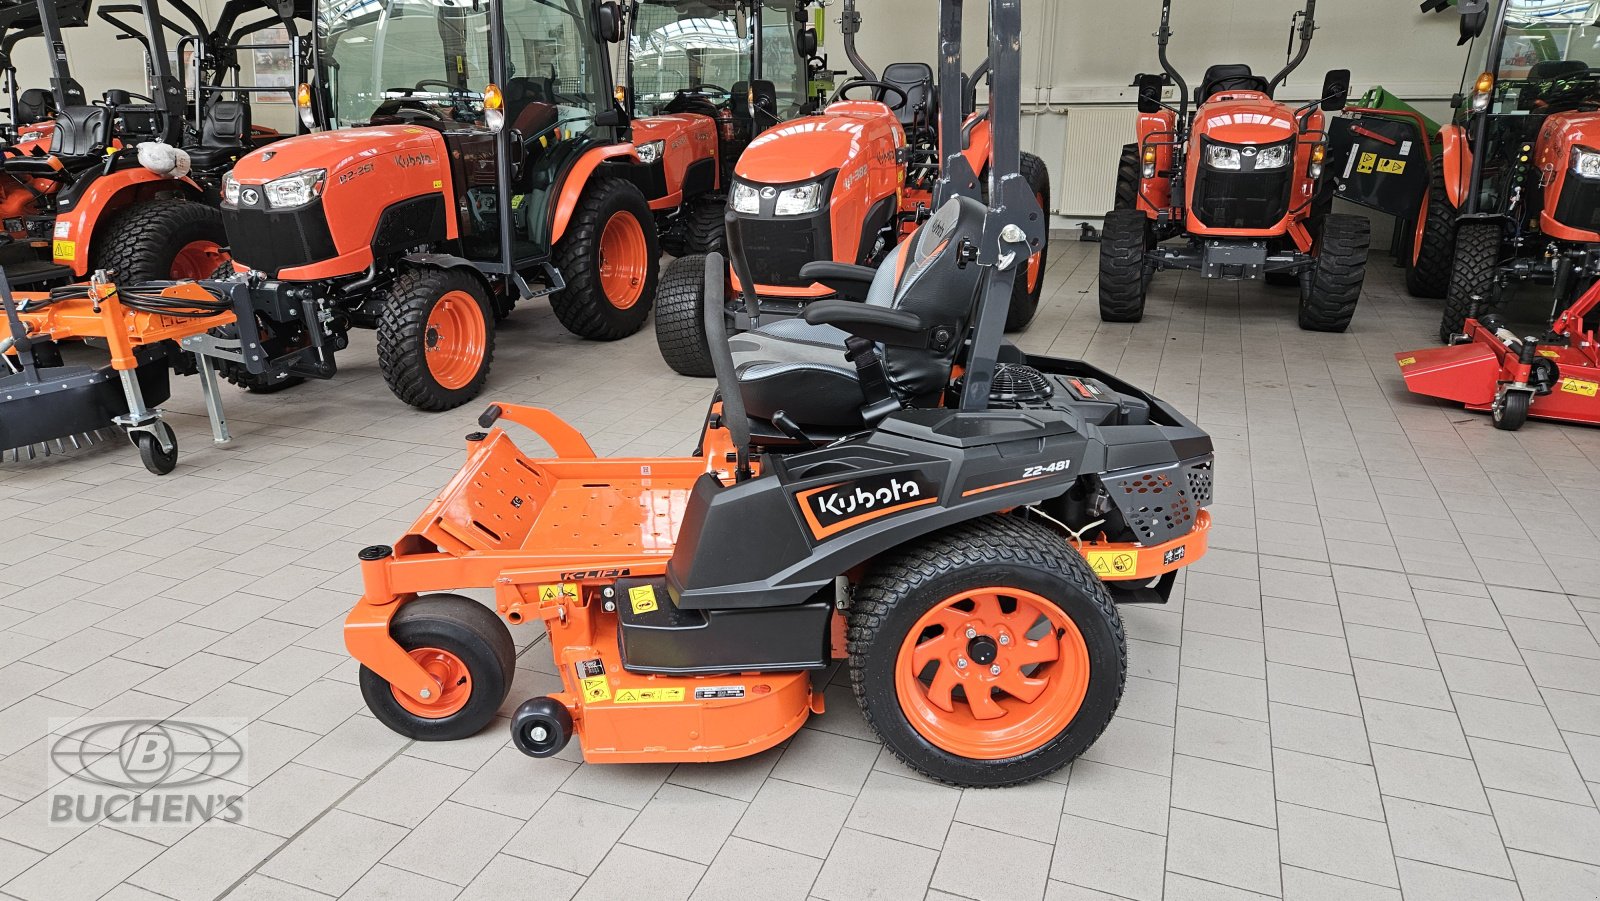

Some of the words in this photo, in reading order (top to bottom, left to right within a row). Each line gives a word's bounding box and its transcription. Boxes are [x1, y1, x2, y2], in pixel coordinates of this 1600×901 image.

[394, 152, 432, 168] Kubota
[1022, 459, 1071, 478] Z2-481
[818, 478, 920, 516] Kubota
[562, 568, 629, 581] K-LIFT
